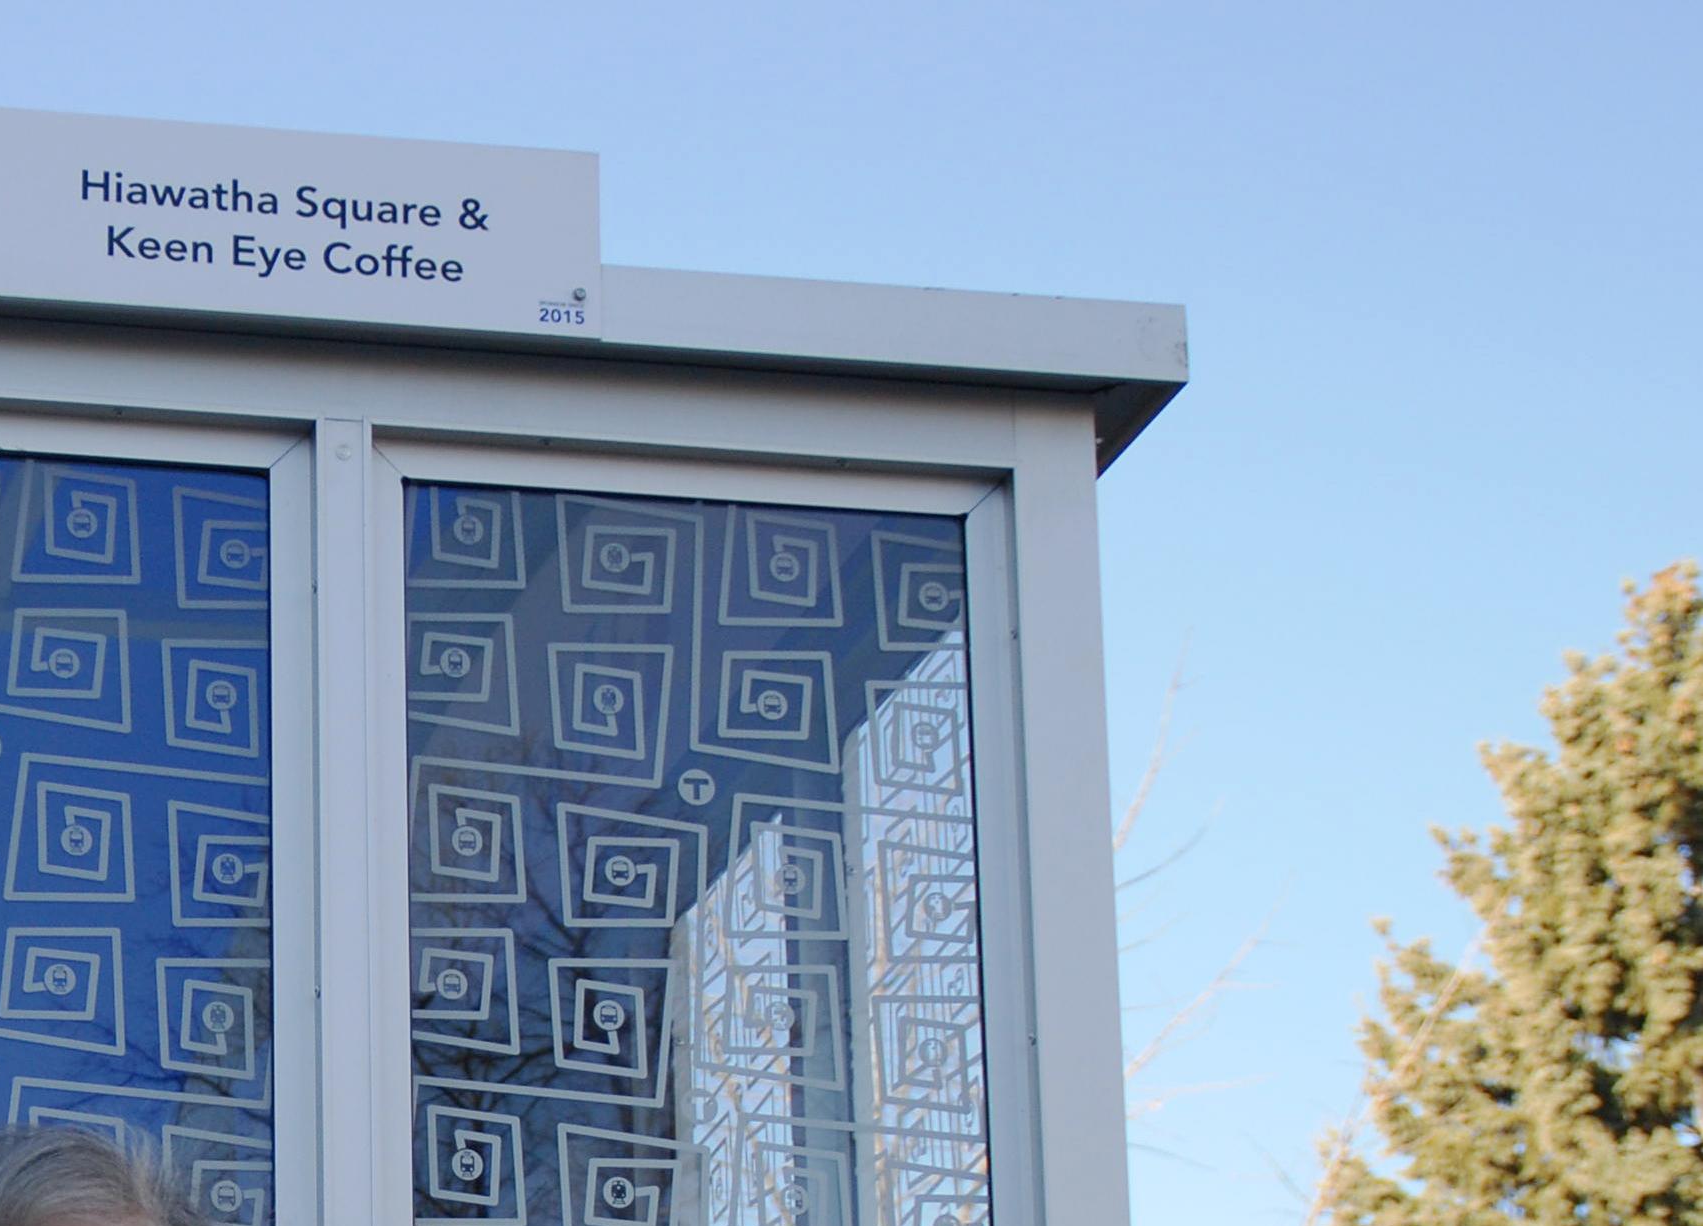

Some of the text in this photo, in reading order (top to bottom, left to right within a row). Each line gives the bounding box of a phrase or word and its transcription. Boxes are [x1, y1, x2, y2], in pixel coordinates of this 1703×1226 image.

[80, 168, 491, 233] Hiawatha Square &
[105, 225, 465, 283] Keen Eye Coffee
[539, 307, 585, 325] 2015
